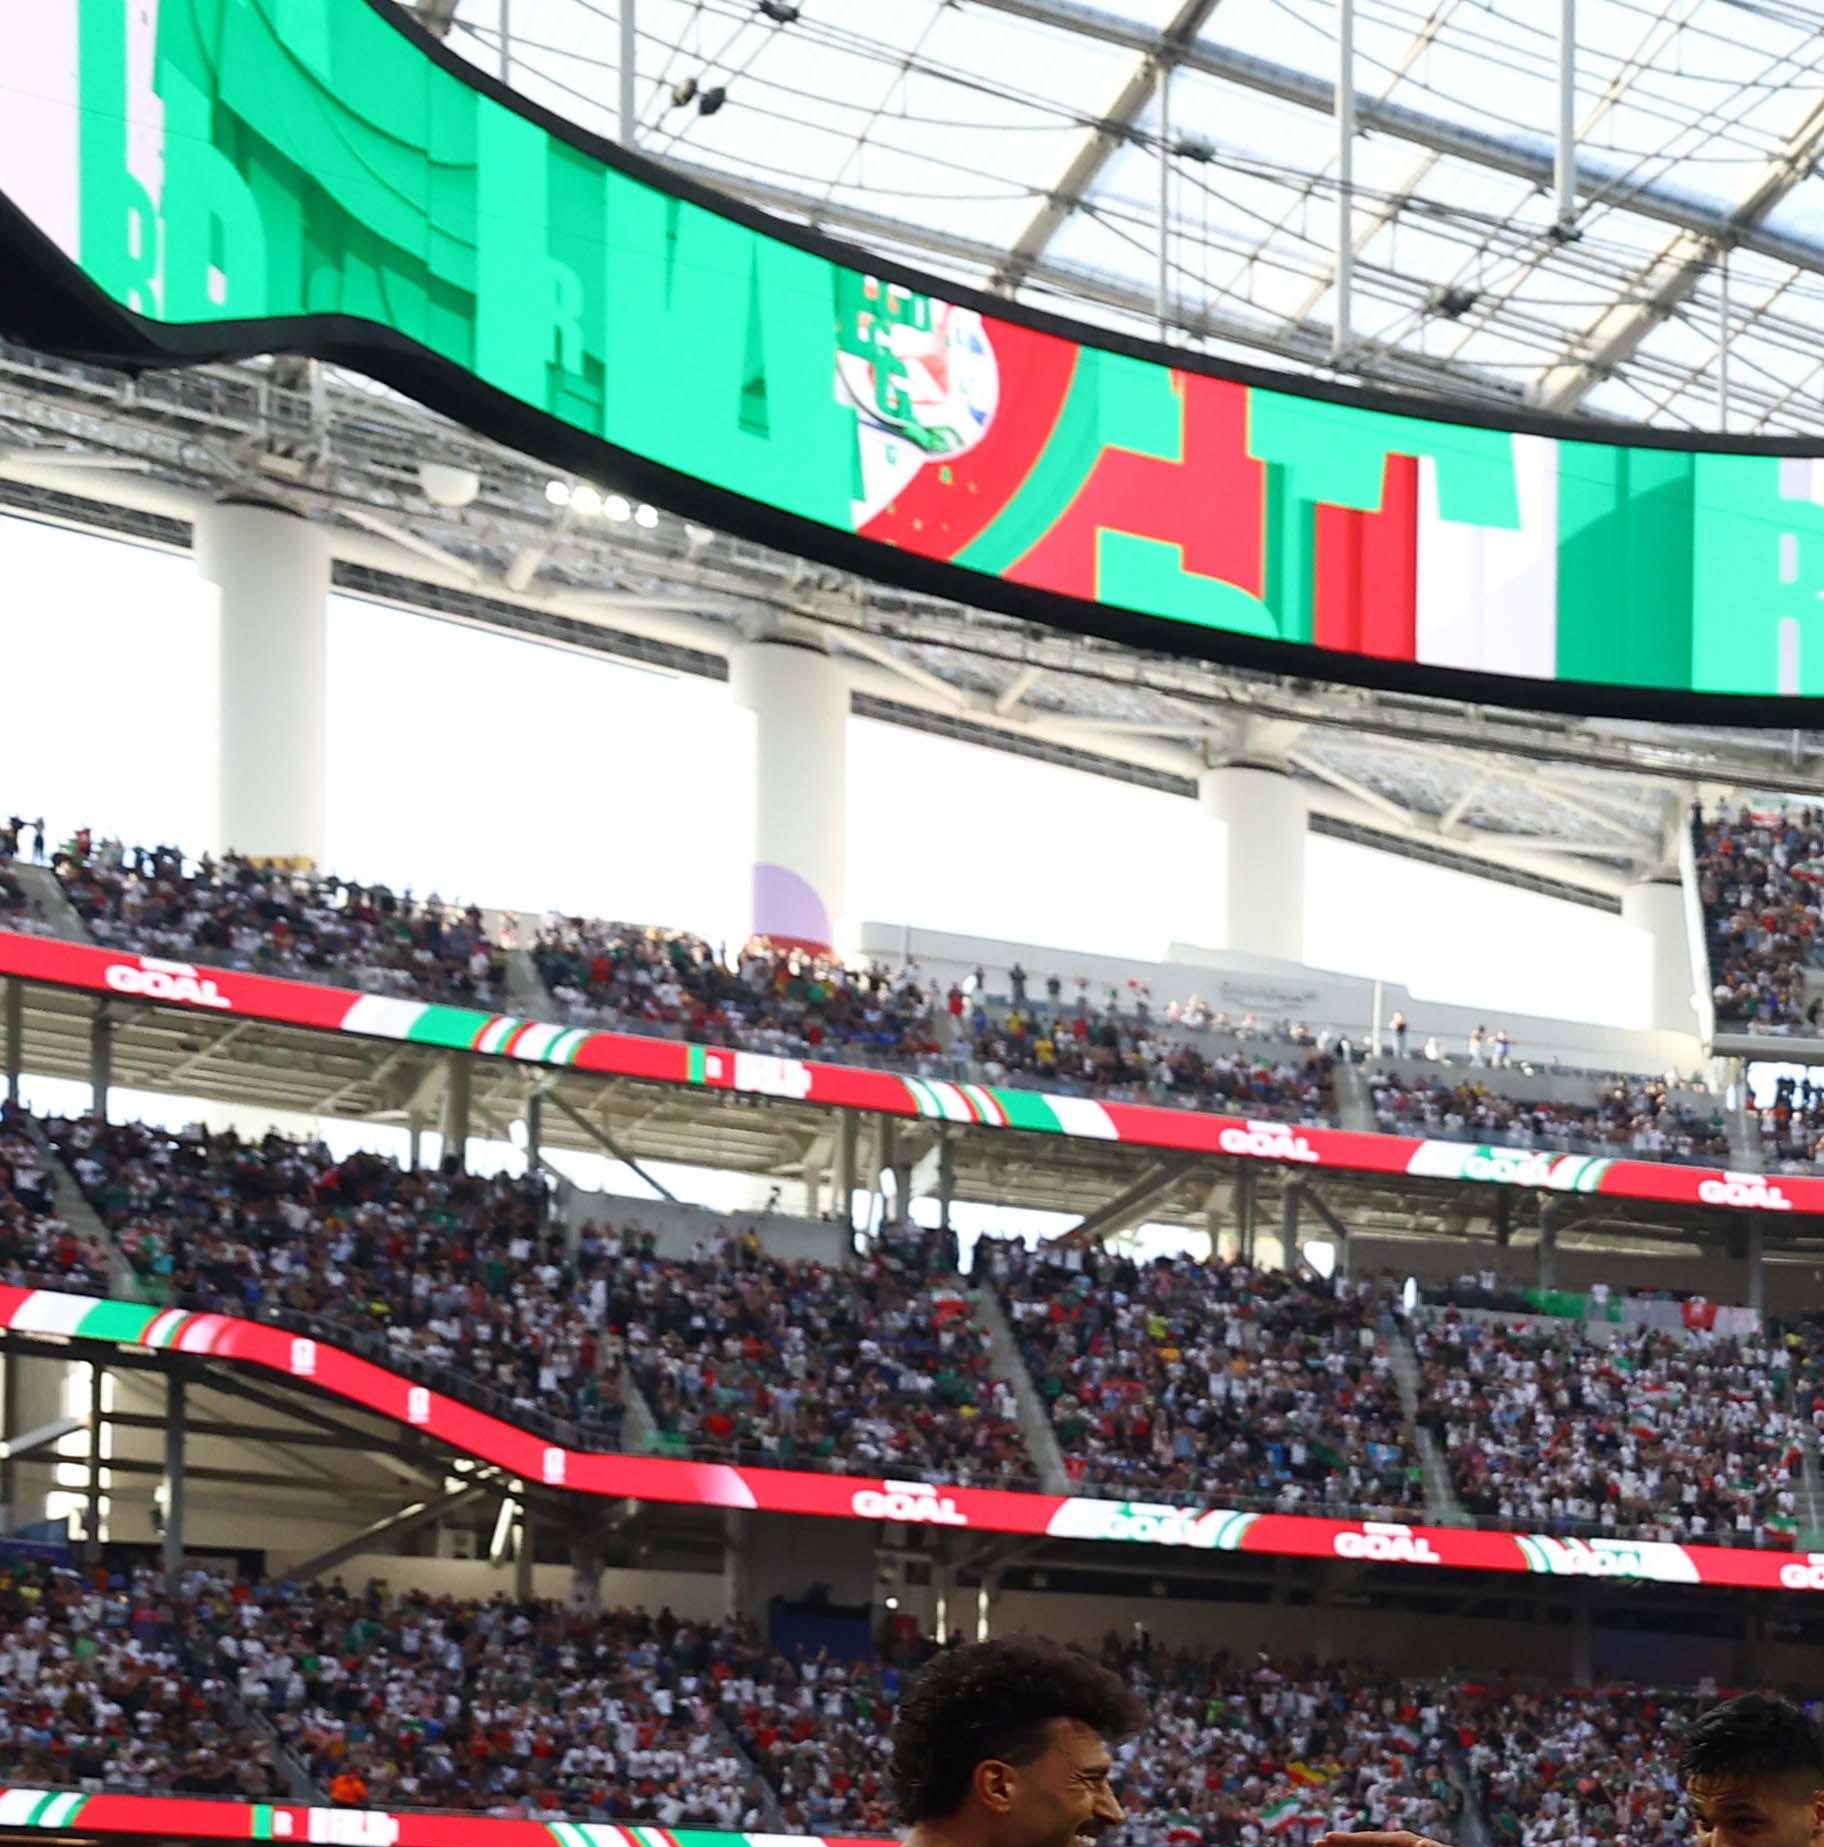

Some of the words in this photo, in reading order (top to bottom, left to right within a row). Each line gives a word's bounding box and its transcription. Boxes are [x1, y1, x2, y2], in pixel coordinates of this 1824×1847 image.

[105, 964, 232, 1008] GOAL
[1219, 1128, 1320, 1162] GOAL
[1698, 1180, 1792, 1210] GOAL
[852, 1490, 968, 1526] GOAL
[1333, 1531, 1441, 1564] GOAL
